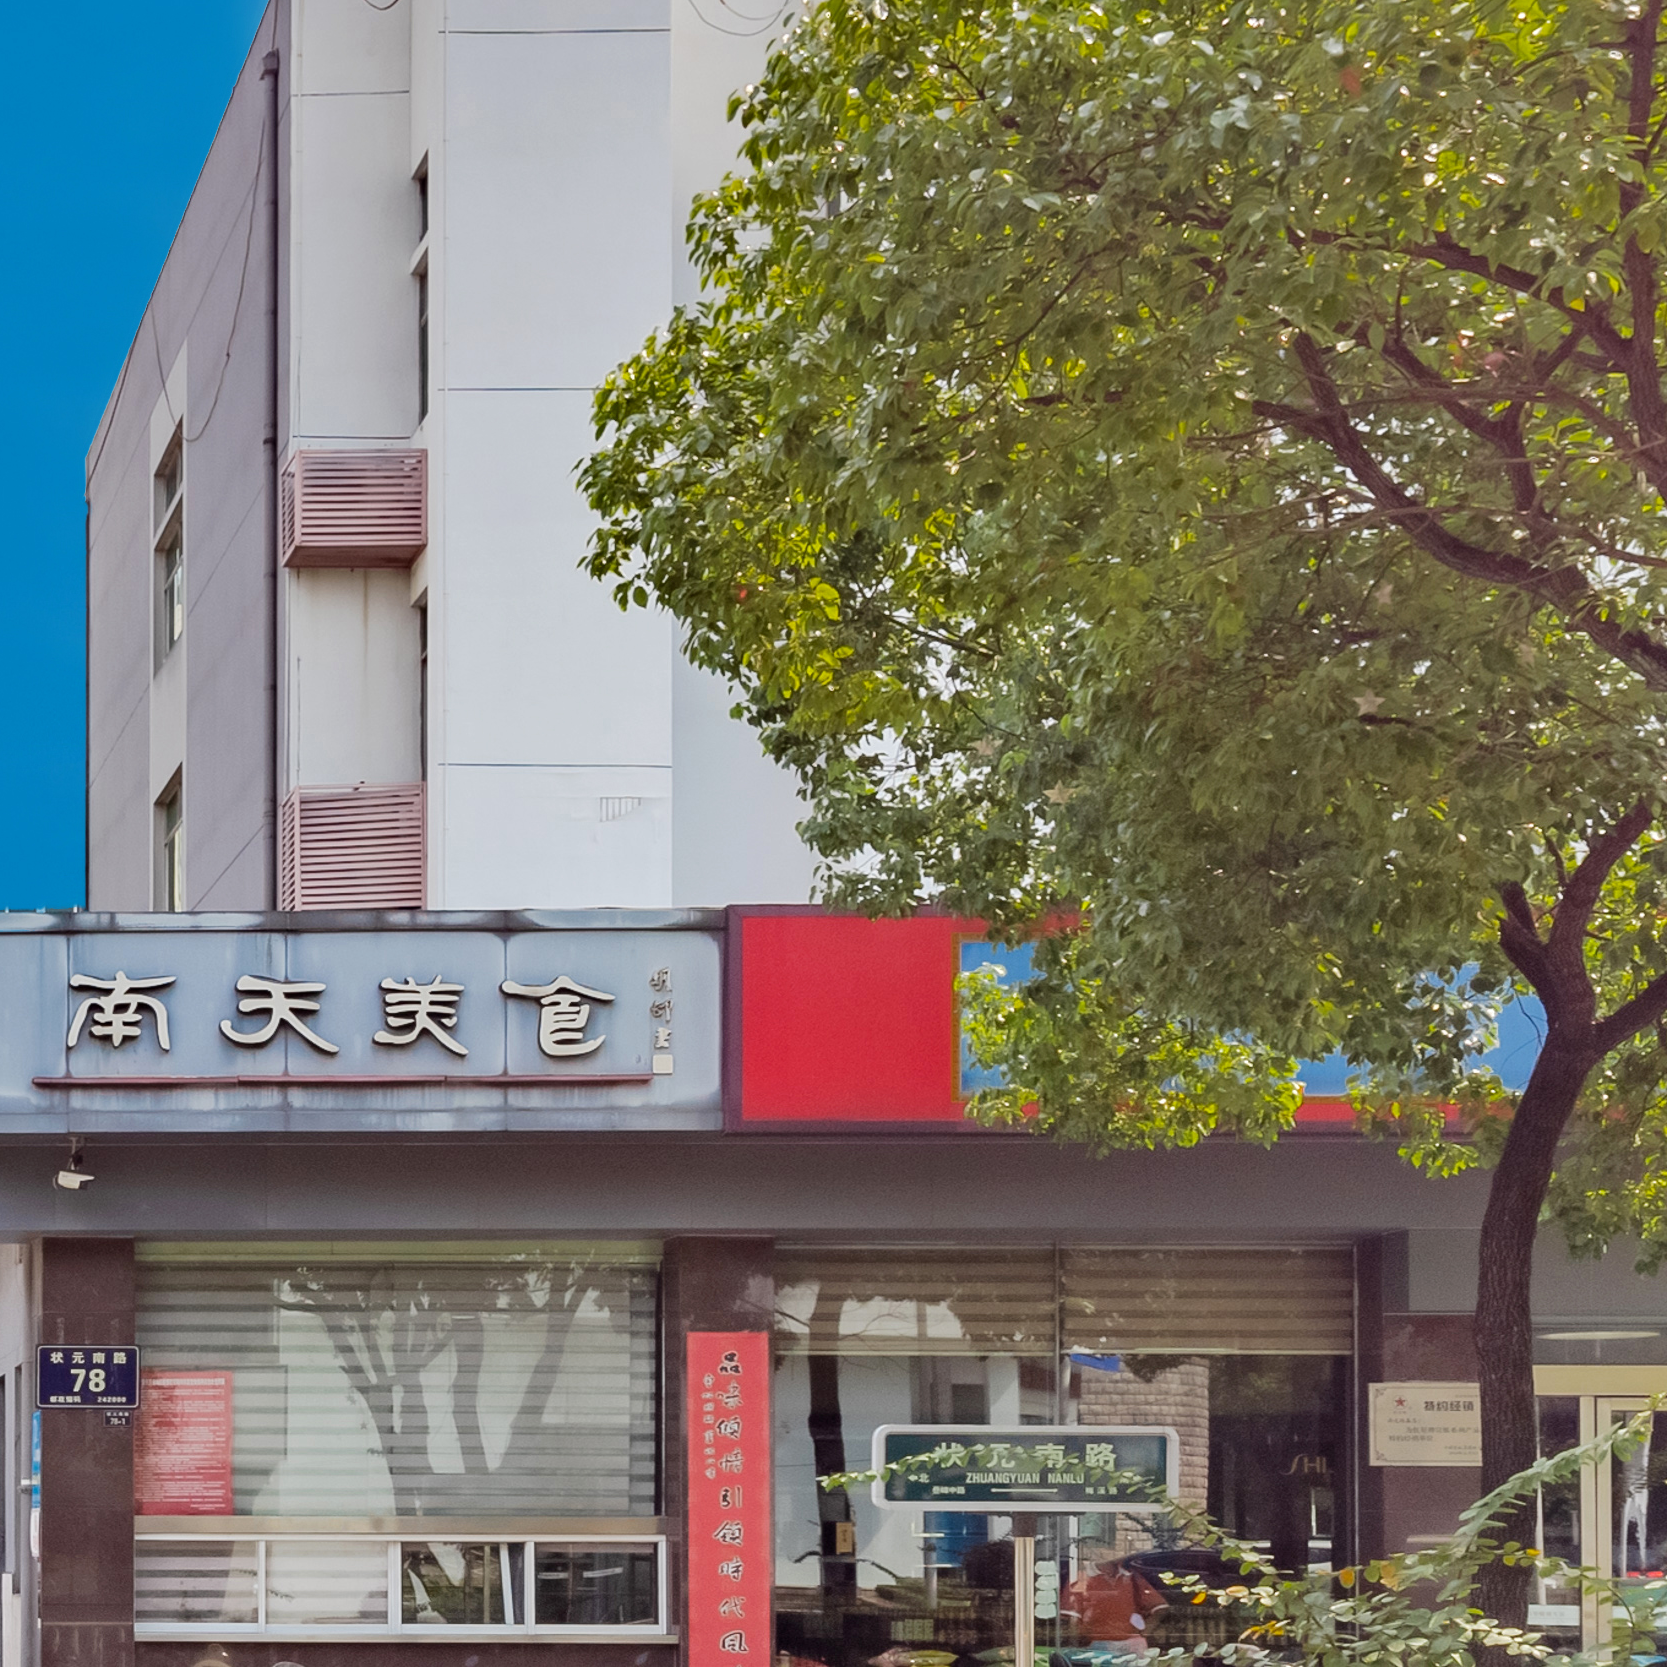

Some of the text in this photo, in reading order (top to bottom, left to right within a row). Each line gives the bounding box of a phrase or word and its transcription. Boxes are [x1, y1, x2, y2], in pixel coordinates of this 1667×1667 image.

[67, 969, 616, 1057] 南天美食
[49, 1351, 127, 1365] 状元南路
[70, 1368, 106, 1393] 78
[932, 1441, 1117, 1472] 状元南路
[965, 1472, 1085, 1485] ZHUANGYUAN NANLU
